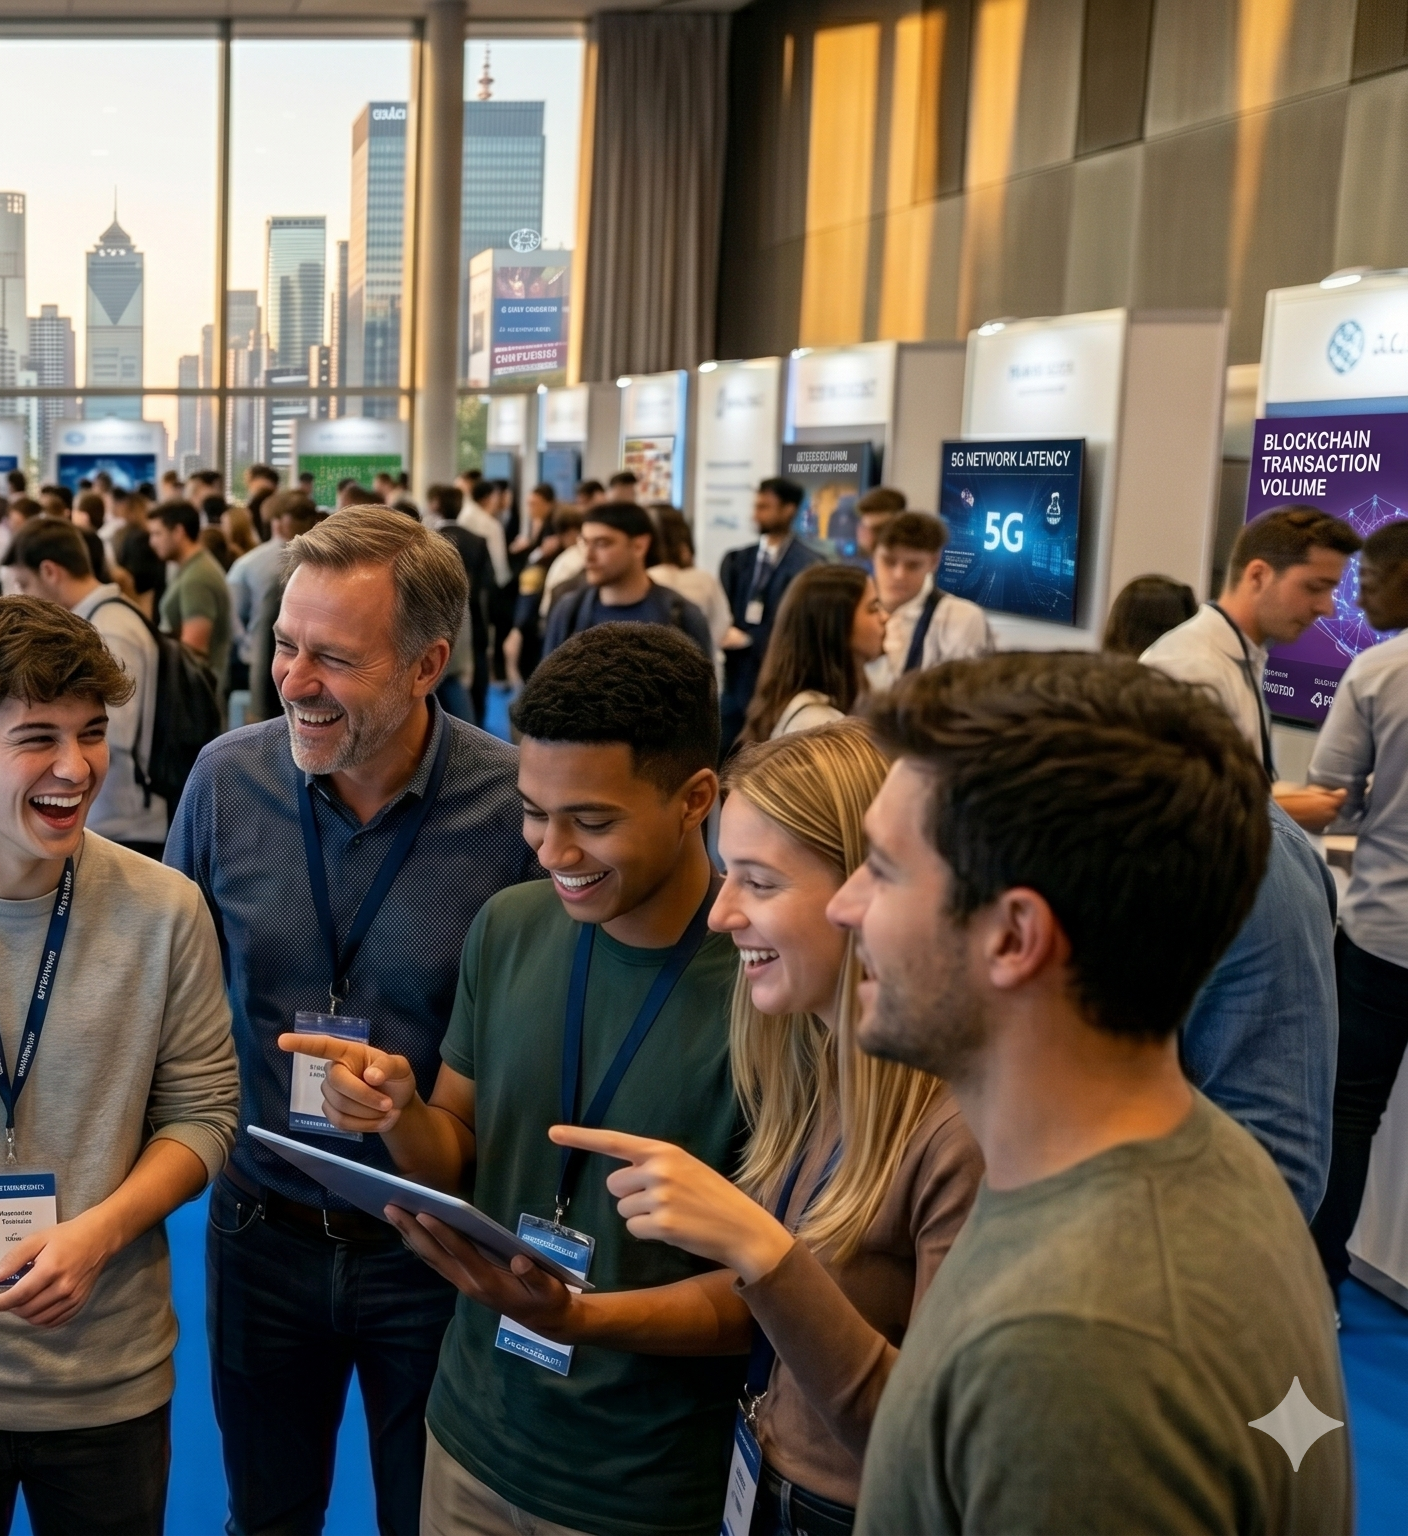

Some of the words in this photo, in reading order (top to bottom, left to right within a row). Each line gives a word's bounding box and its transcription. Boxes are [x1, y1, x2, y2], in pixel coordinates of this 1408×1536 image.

[1263, 430, 1371, 451] BLOCKCHAIN
[951, 452, 964, 467] 5G
[966, 451, 1017, 467] NETWORK
[1019, 450, 1071, 467] LATENCY
[1261, 453, 1381, 473] TRANSACTION
[1260, 478, 1327, 497] VOLUME
[983, 511, 1024, 553] 5G
